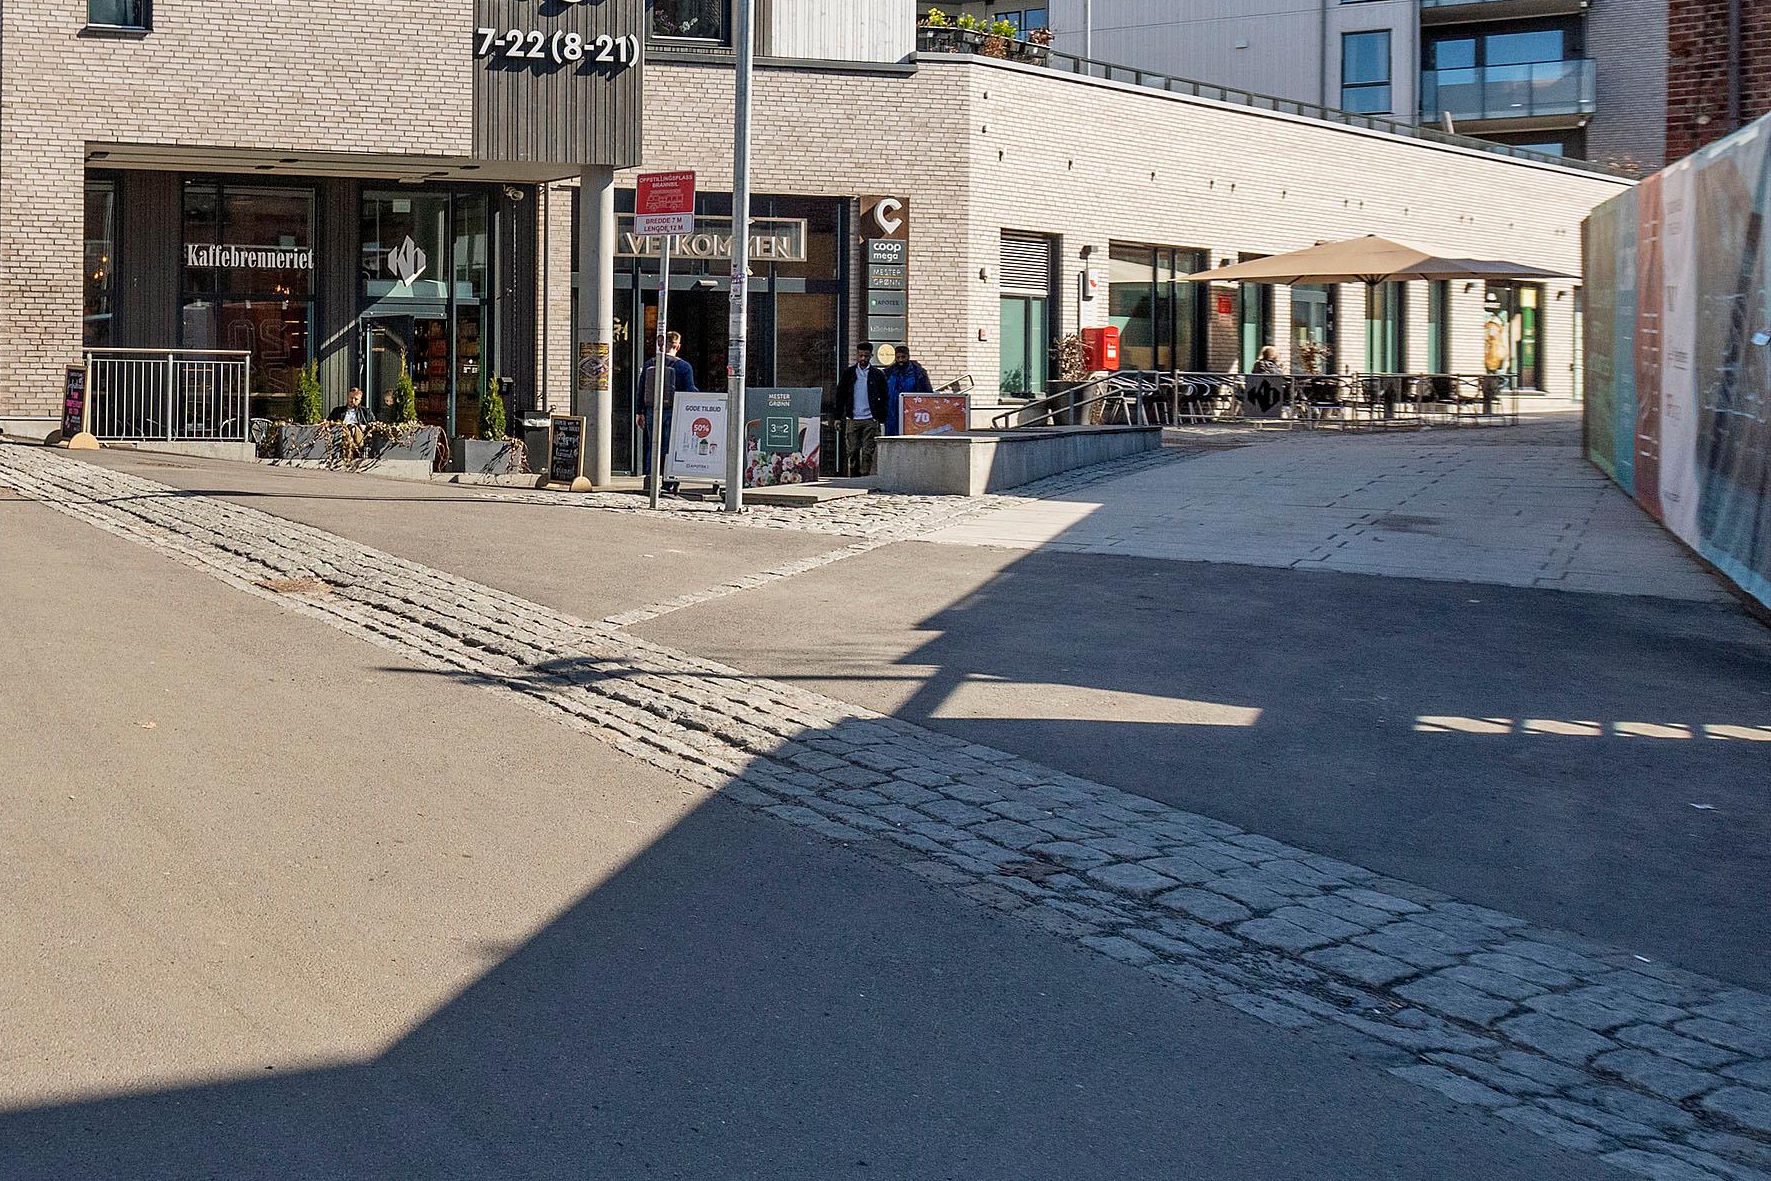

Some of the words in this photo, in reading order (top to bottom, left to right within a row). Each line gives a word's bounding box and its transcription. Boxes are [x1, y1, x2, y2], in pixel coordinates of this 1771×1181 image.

[478, 27, 546, 59] 7-22
[551, 29, 640, 68] (8-21)
[625, 232, 791, 259] VEKOMEN
[873, 242, 901, 253] coop
[186, 244, 314, 269] Kaffebrenneriet
[873, 252, 899, 262] mega
[873, 268, 901, 276] MESTER
[914, 412, 930, 423] 70
[693, 424, 710, 432] 50%
[770, 424, 777, 433] 3
[783, 424, 789, 433] 2
